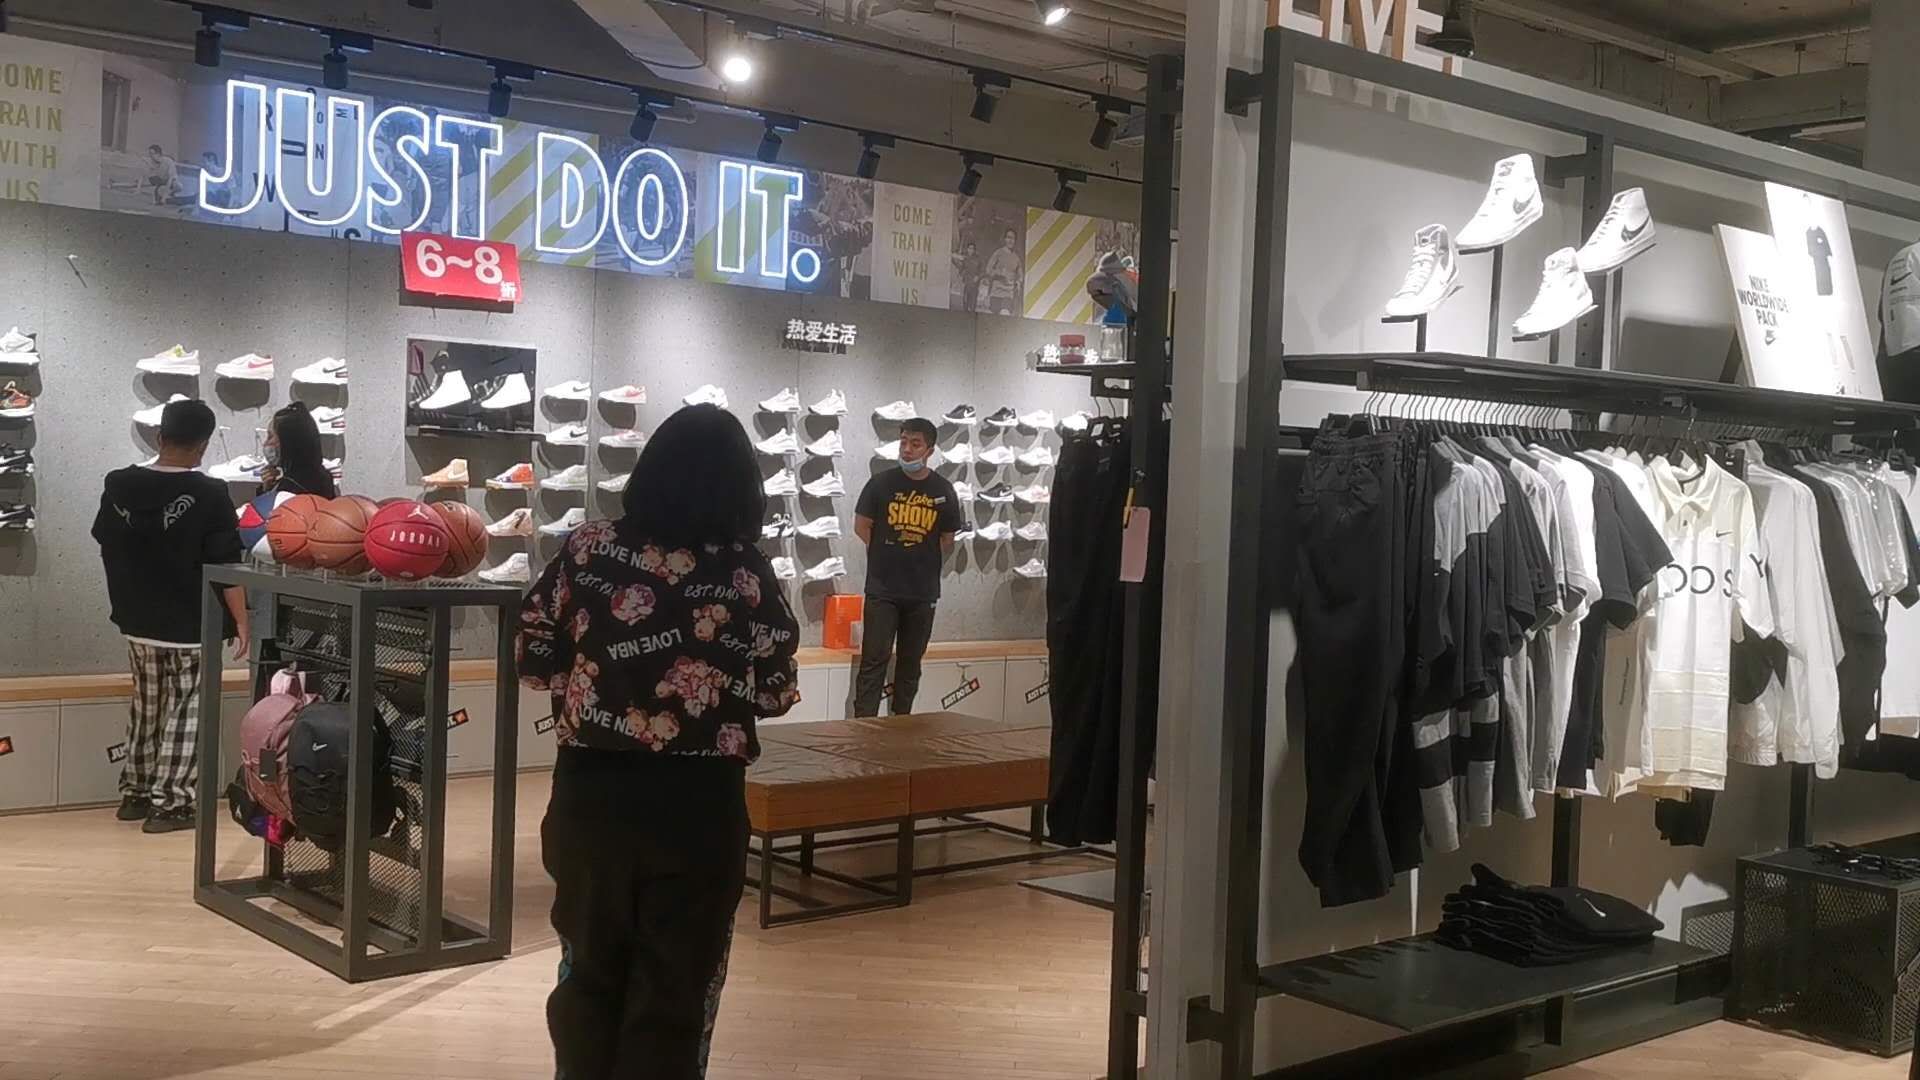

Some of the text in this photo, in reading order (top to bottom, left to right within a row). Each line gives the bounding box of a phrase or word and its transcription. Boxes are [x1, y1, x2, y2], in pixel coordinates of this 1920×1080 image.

[0, 63, 62, 94] OME
[199, 79, 503, 241] JUST
[535, 132, 688, 266] DO
[717, 160, 820, 282] IT.
[894, 203, 932, 226] COME
[892, 231, 932, 254] TRAIN
[893, 260, 929, 281] WITH
[1748, 274, 1769, 292] NIKE
[901, 288, 919, 305] US
[1755, 309, 1779, 328] PACK
[786, 318, 857, 345] 热爱生活
[906, 489, 934, 508] Lake
[887, 501, 938, 532] SHOW
[590, 540, 629, 562] LOVE
[606, 628, 682, 661] LOVE NBA
